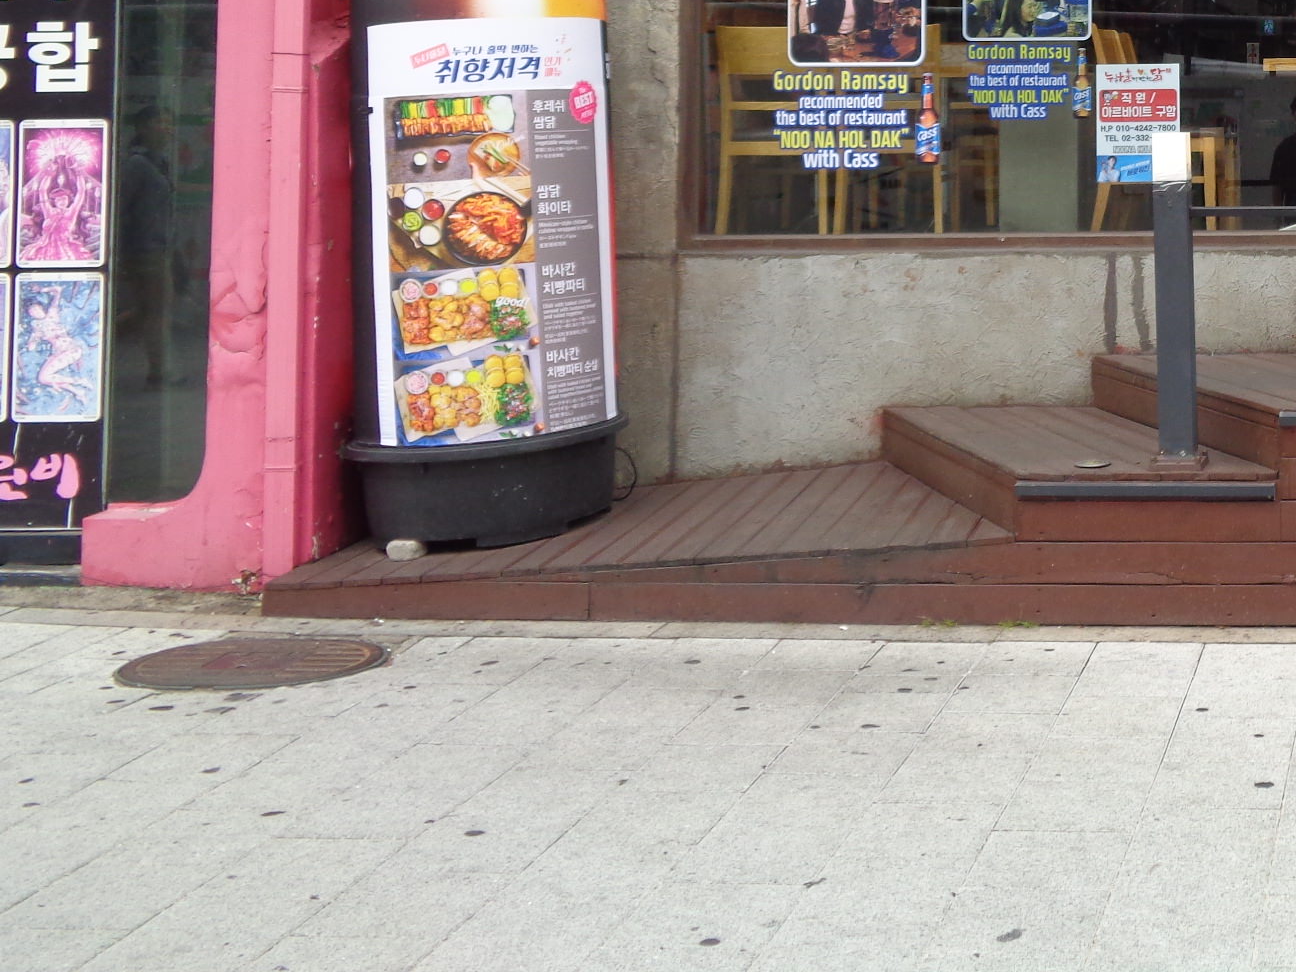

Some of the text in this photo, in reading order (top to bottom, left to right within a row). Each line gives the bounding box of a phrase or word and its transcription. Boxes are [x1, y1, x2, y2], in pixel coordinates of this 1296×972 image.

[452, 45, 483, 57] 누구나
[968, 43, 1071, 63] Gordon Ramsay
[433, 55, 542, 84] 취향저격
[987, 62, 1050, 75] recommended
[773, 70, 909, 95] Gordon Ramsay
[969, 74, 1067, 88] the best of restaurant
[799, 93, 884, 110] recommended
[998, 89, 1014, 104] NA
[1017, 89, 1038, 104] HOL
[532, 99, 566, 114] 후레쉬
[990, 103, 1047, 118] with Cass
[1101, 105, 1177, 119] 아르바이트 구함
[775, 109, 907, 126] the best of restaurant
[814, 129, 835, 149] NA
[839, 129, 867, 149] HOL
[1105, 135, 1118, 143] TEL
[803, 149, 879, 169] with Cass
[536, 200, 573, 216] 화이타
[541, 262, 577, 278] 바사칸
[546, 346, 580, 364] 바사칸
